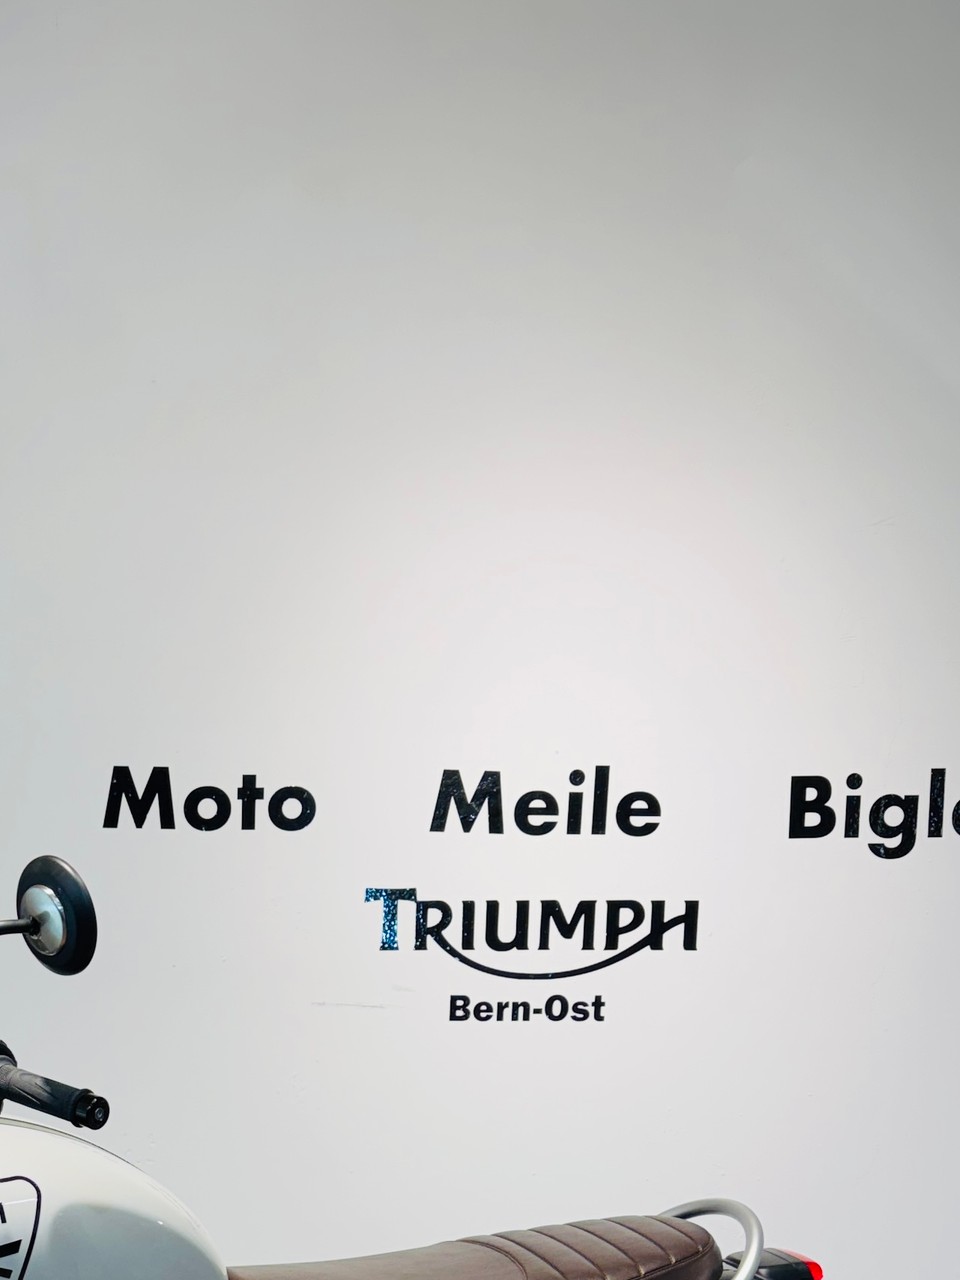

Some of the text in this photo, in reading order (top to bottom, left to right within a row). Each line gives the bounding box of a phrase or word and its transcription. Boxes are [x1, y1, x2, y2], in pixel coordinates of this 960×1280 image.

[103, 766, 316, 831] Moto
[430, 766, 661, 836] Meile
[365, 888, 699, 980] TRIUMPH
[449, 995, 605, 1021] Bern-Ost
